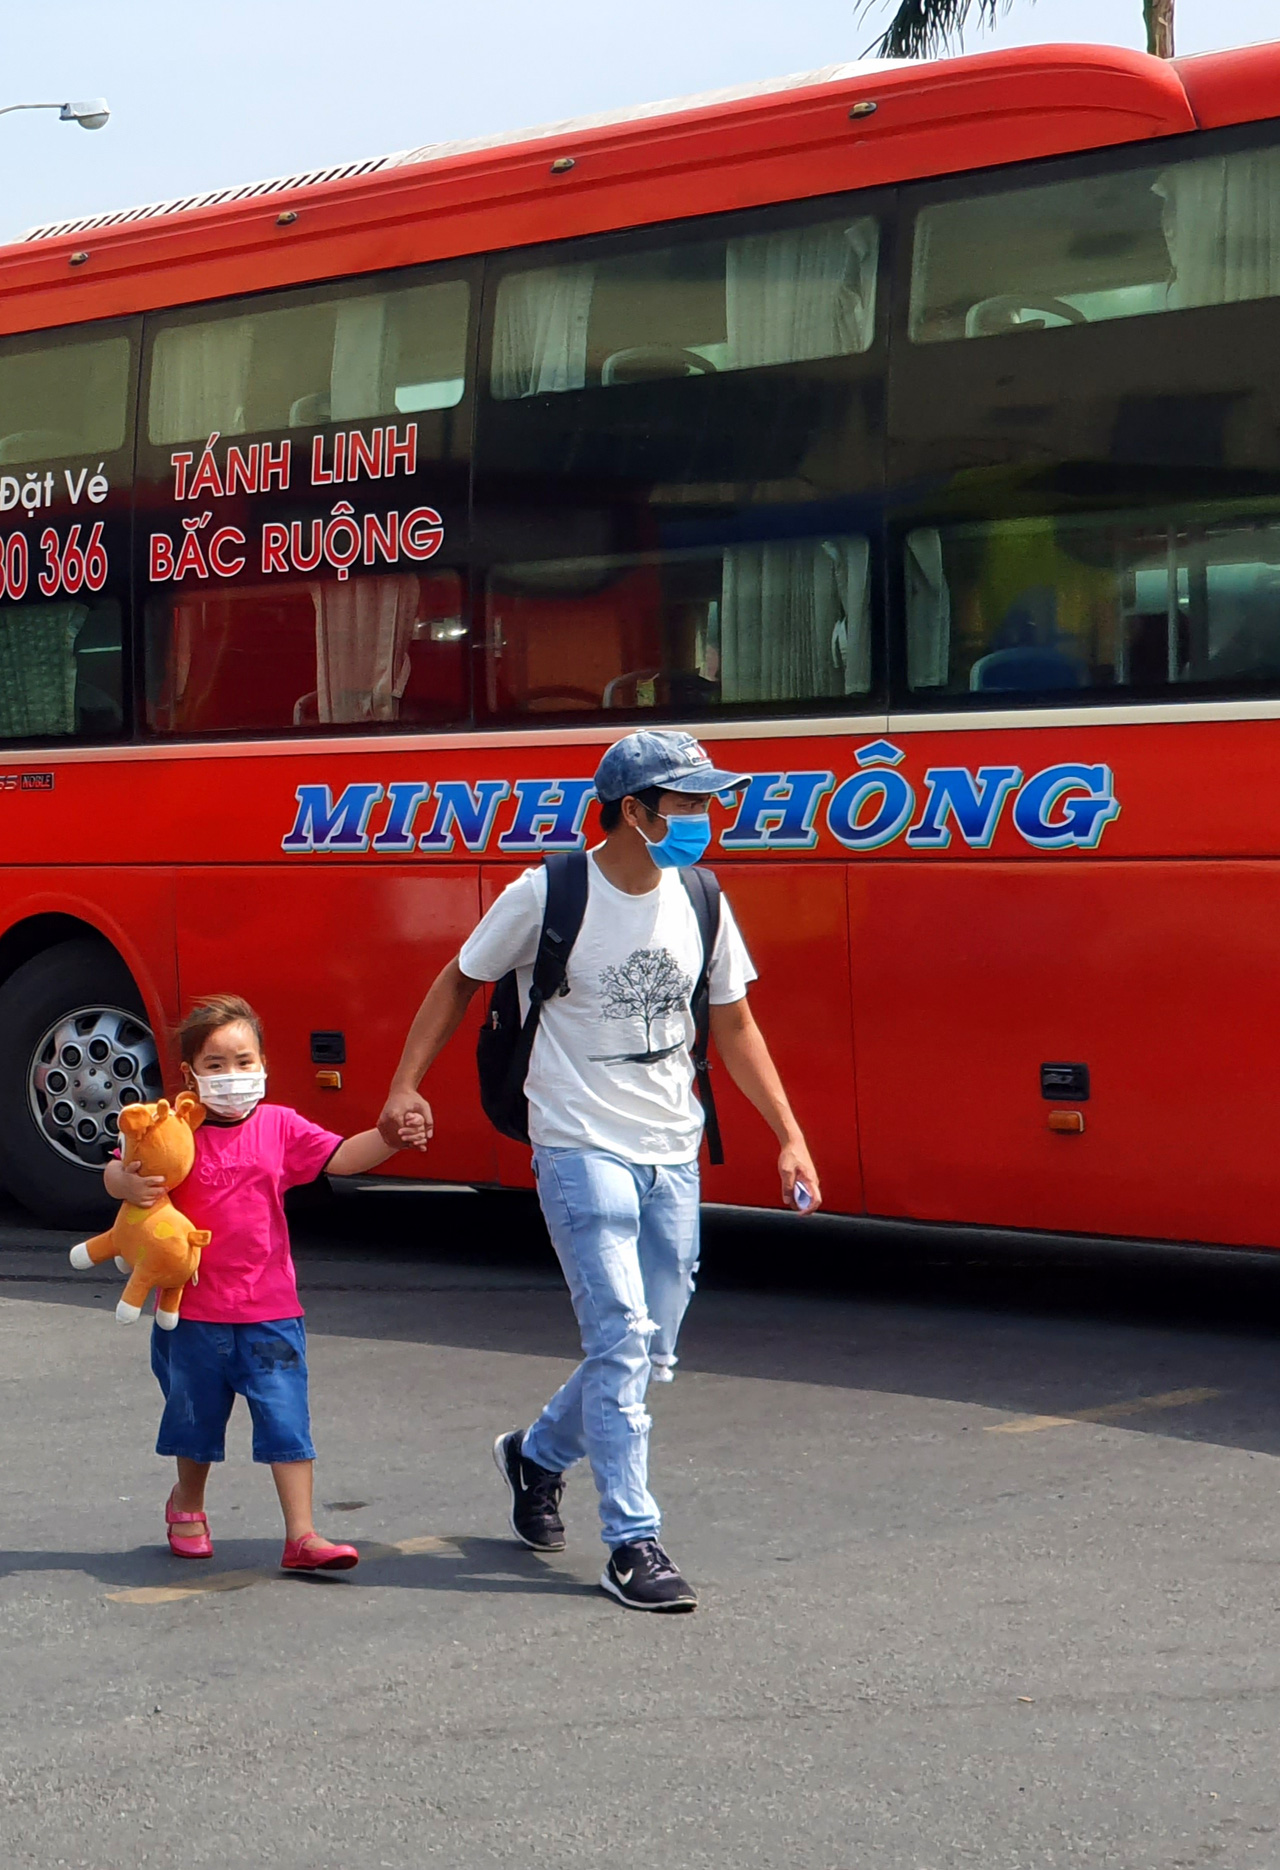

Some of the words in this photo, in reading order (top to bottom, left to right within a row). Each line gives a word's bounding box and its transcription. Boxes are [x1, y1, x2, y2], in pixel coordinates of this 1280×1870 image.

[64, 462, 109, 504] Vé
[171, 432, 291, 500] TÁNH
[311, 423, 418, 486] LINH
[38, 521, 108, 596] 366
[149, 512, 246, 582] BẮC
[262, 501, 444, 581] RUỘNG
[21, 774, 52, 789] NOBLE
[281, 778, 597, 853] MINH
[713, 738, 1122, 851] HÔNG
